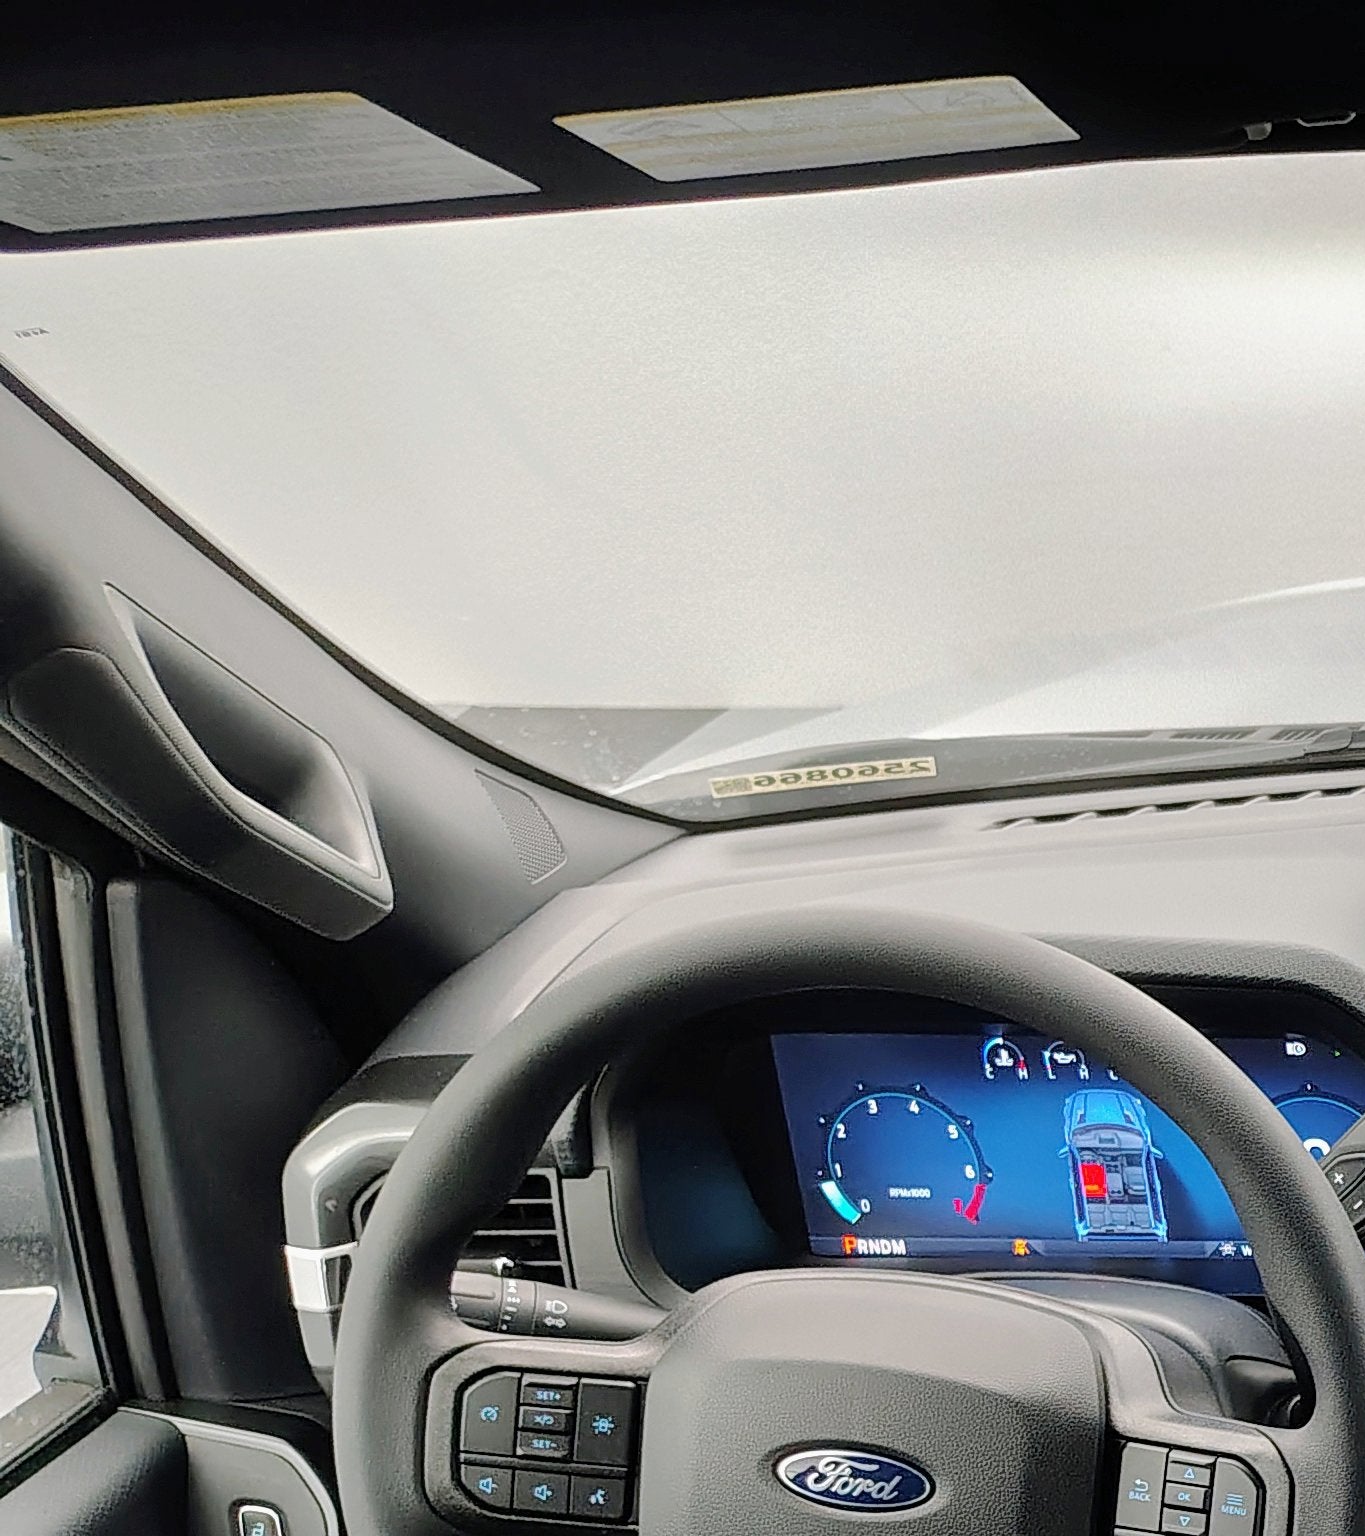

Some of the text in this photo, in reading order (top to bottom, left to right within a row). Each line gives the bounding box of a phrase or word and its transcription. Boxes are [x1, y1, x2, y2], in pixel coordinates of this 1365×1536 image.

[868, 1100, 878, 1114] 3
[910, 1100, 920, 1114] 4
[837, 1124, 846, 1138] 2
[834, 1163, 843, 1178] 1
[965, 1164, 975, 1179] 6
[861, 1198, 871, 1213] 0
[805, 1456, 903, 1501] Ford
[1128, 1490, 1151, 1502] BACK
[1177, 1493, 1191, 1502] OK
[1220, 1505, 1247, 1516] MENU
